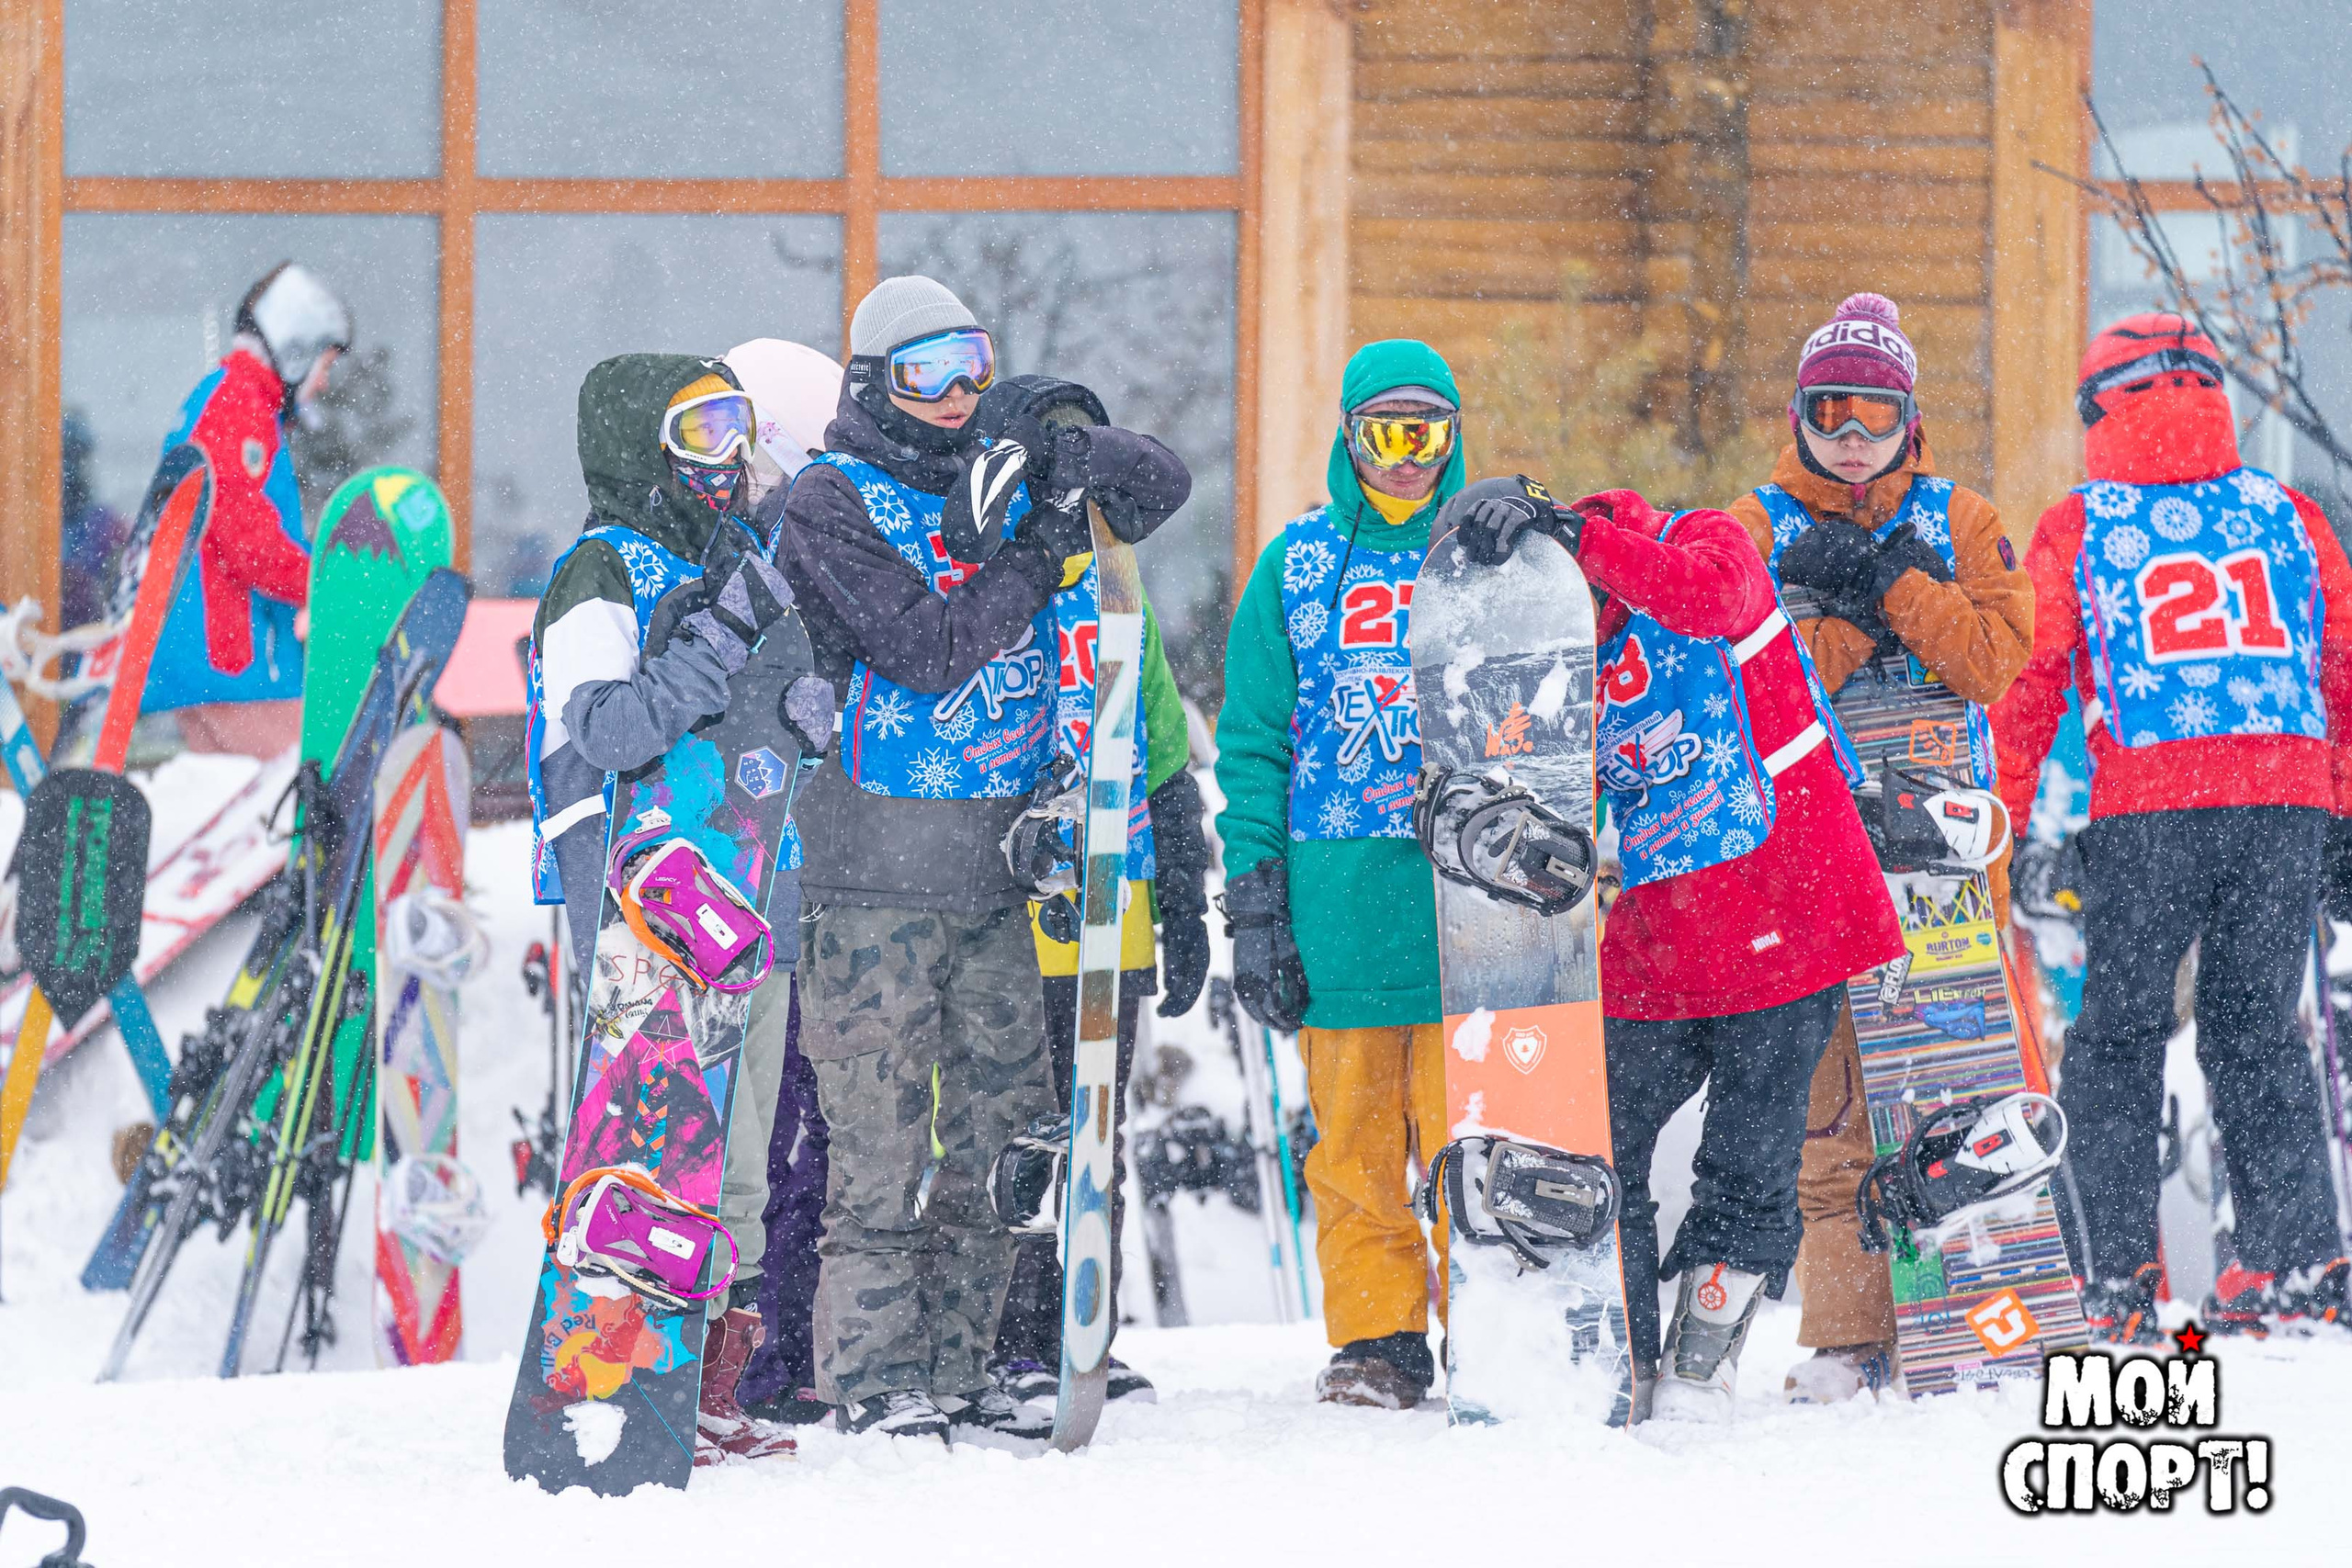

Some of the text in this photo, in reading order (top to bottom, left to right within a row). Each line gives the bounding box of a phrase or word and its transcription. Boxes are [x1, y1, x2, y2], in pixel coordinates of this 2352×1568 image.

[2137, 553, 2290, 661] 21
[963, 738, 1002, 762] Отдых
[1002, 722, 1025, 743] всей
[979, 762, 987, 773] и
[989, 747, 1021, 770] летом
[1363, 781, 1404, 803] Отдых
[1378, 803, 1386, 815] и
[1623, 822, 1660, 852] Отдых
[1660, 803, 1683, 826] всей
[1639, 849, 1648, 860] и
[1649, 827, 1680, 855] летом
[1680, 820, 1690, 831] и
[1926, 937, 1969, 952] BURTON
[1066, 614, 1143, 1373] NITRO
[540, 1313, 596, 1367] Red Bull
